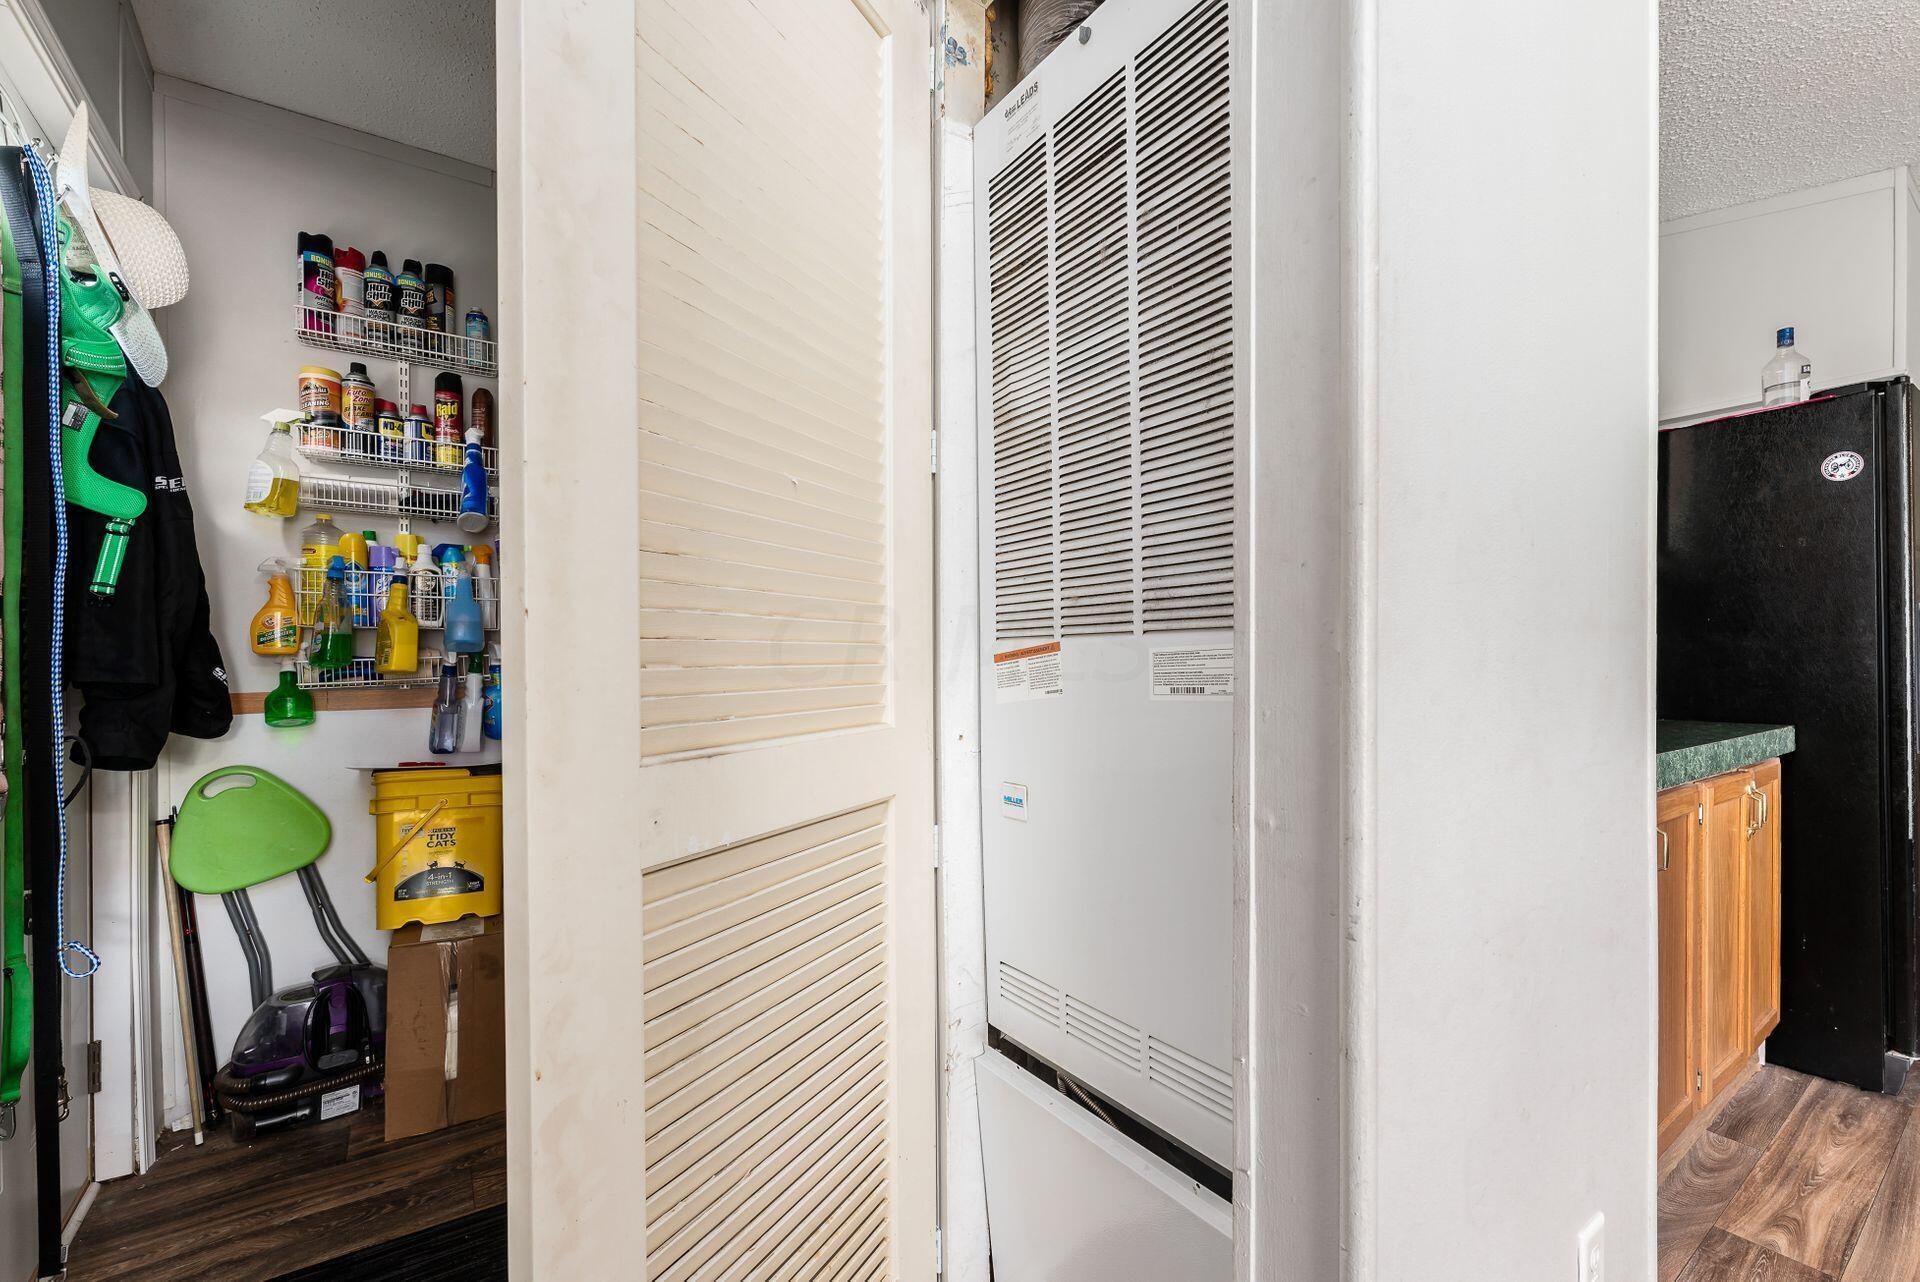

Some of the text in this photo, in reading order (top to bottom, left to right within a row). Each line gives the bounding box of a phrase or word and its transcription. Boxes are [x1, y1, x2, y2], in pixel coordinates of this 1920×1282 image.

[367, 282, 390, 292] HOT
[365, 290, 392, 302] SHOT
[402, 290, 424, 301] HOT
[400, 298, 425, 310] SHOT
[436, 403, 458, 417] Raid
[428, 832, 455, 841] TIDY
[426, 839, 456, 848] CATS
